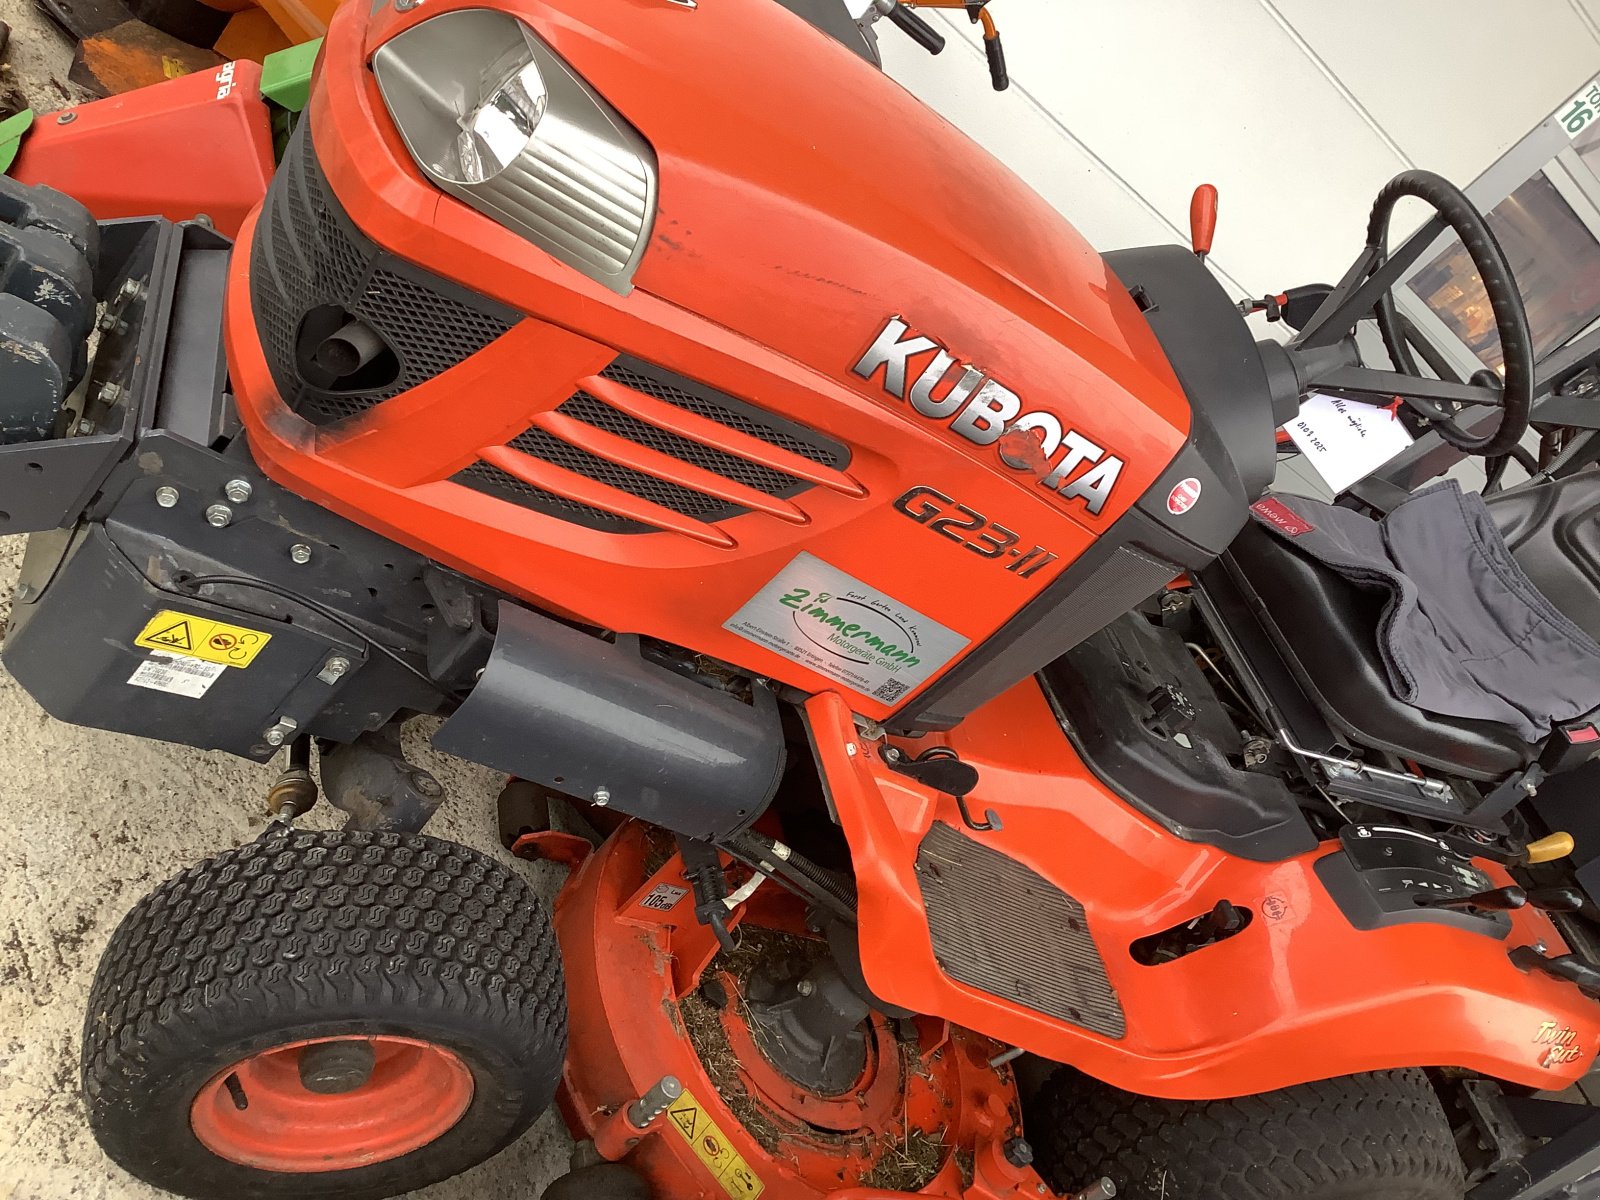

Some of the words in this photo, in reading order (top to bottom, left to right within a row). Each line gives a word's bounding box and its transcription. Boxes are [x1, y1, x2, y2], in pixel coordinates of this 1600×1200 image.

[216, 61, 236, 99] agria
[1561, 100, 1593, 133] 16
[851, 316, 1124, 516] KUBOTA
[846, 591, 867, 601] Forst
[779, 587, 921, 668] Zimmermann
[826, 633, 876, 662] Motorgeräte
[875, 656, 902, 674] GmbH
[1531, 1020, 1578, 1047] Twin
